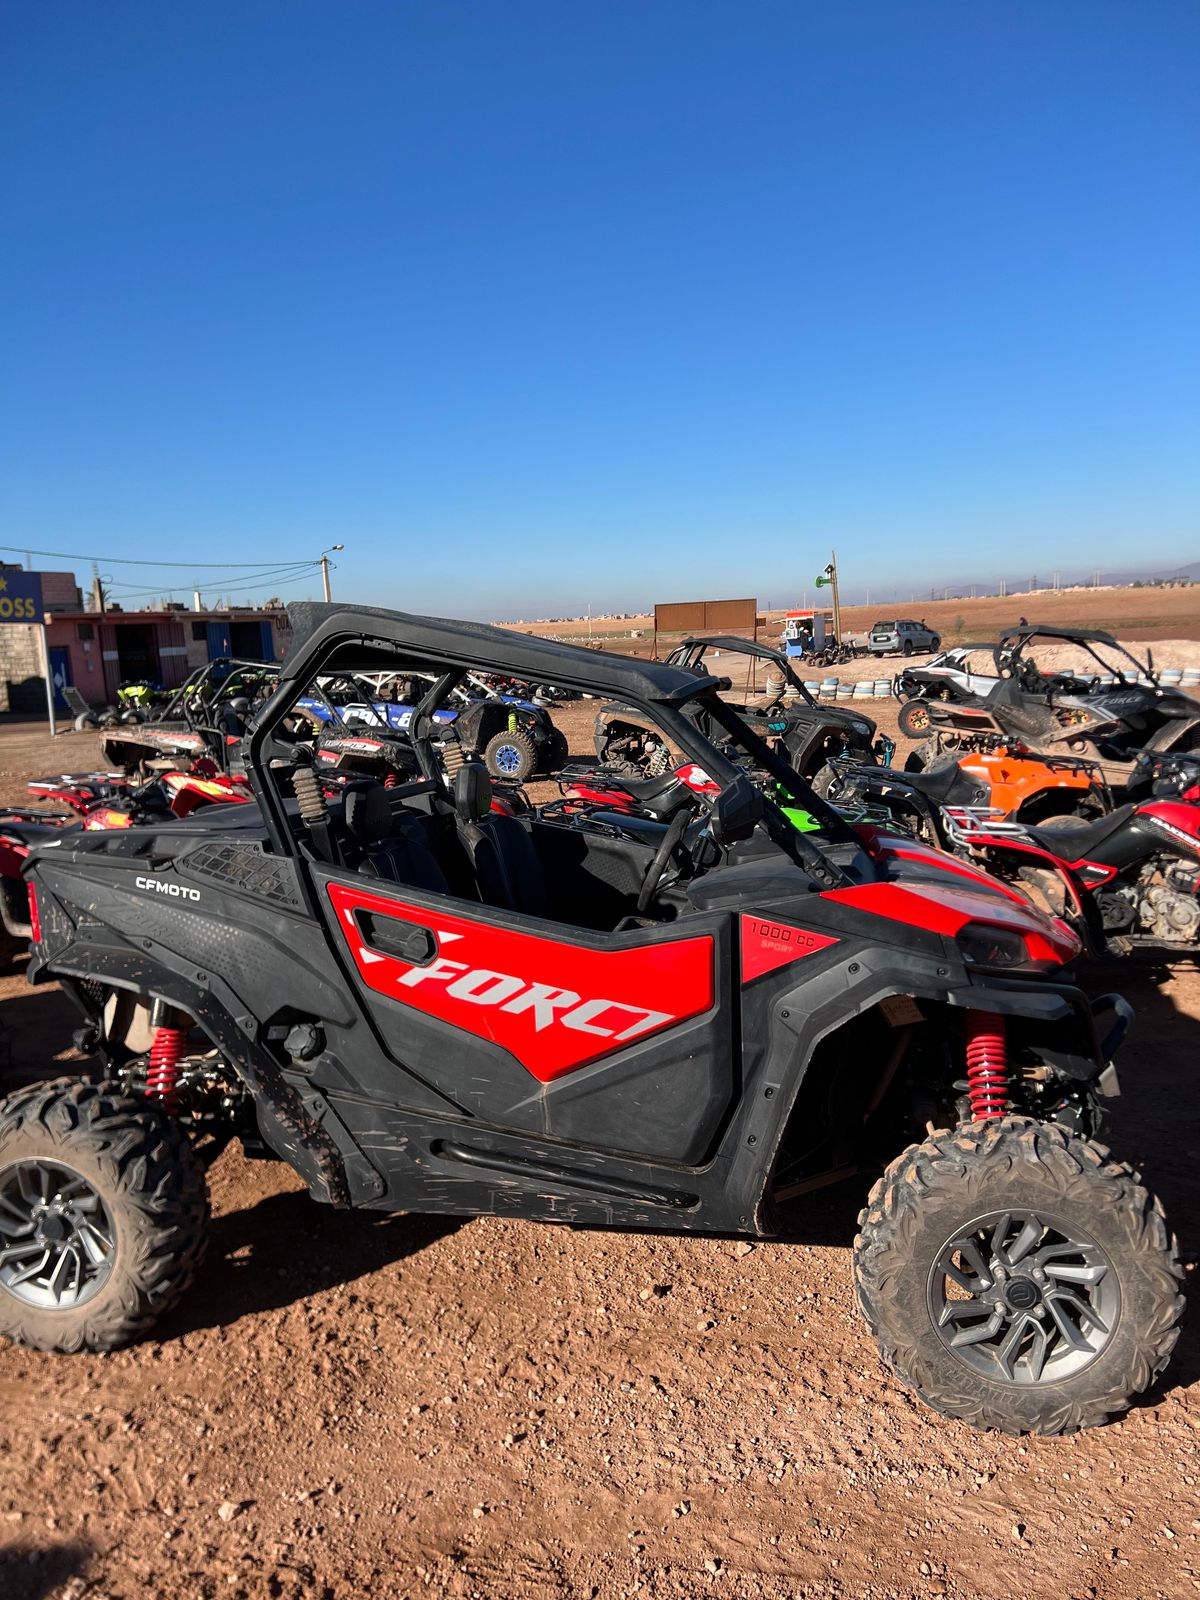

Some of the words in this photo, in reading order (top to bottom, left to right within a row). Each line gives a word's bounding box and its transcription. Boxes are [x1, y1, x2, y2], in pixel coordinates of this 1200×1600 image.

[135, 876, 201, 902] CFMOTO
[751, 922, 792, 942] 1000
[760, 939, 795, 954] SPORT
